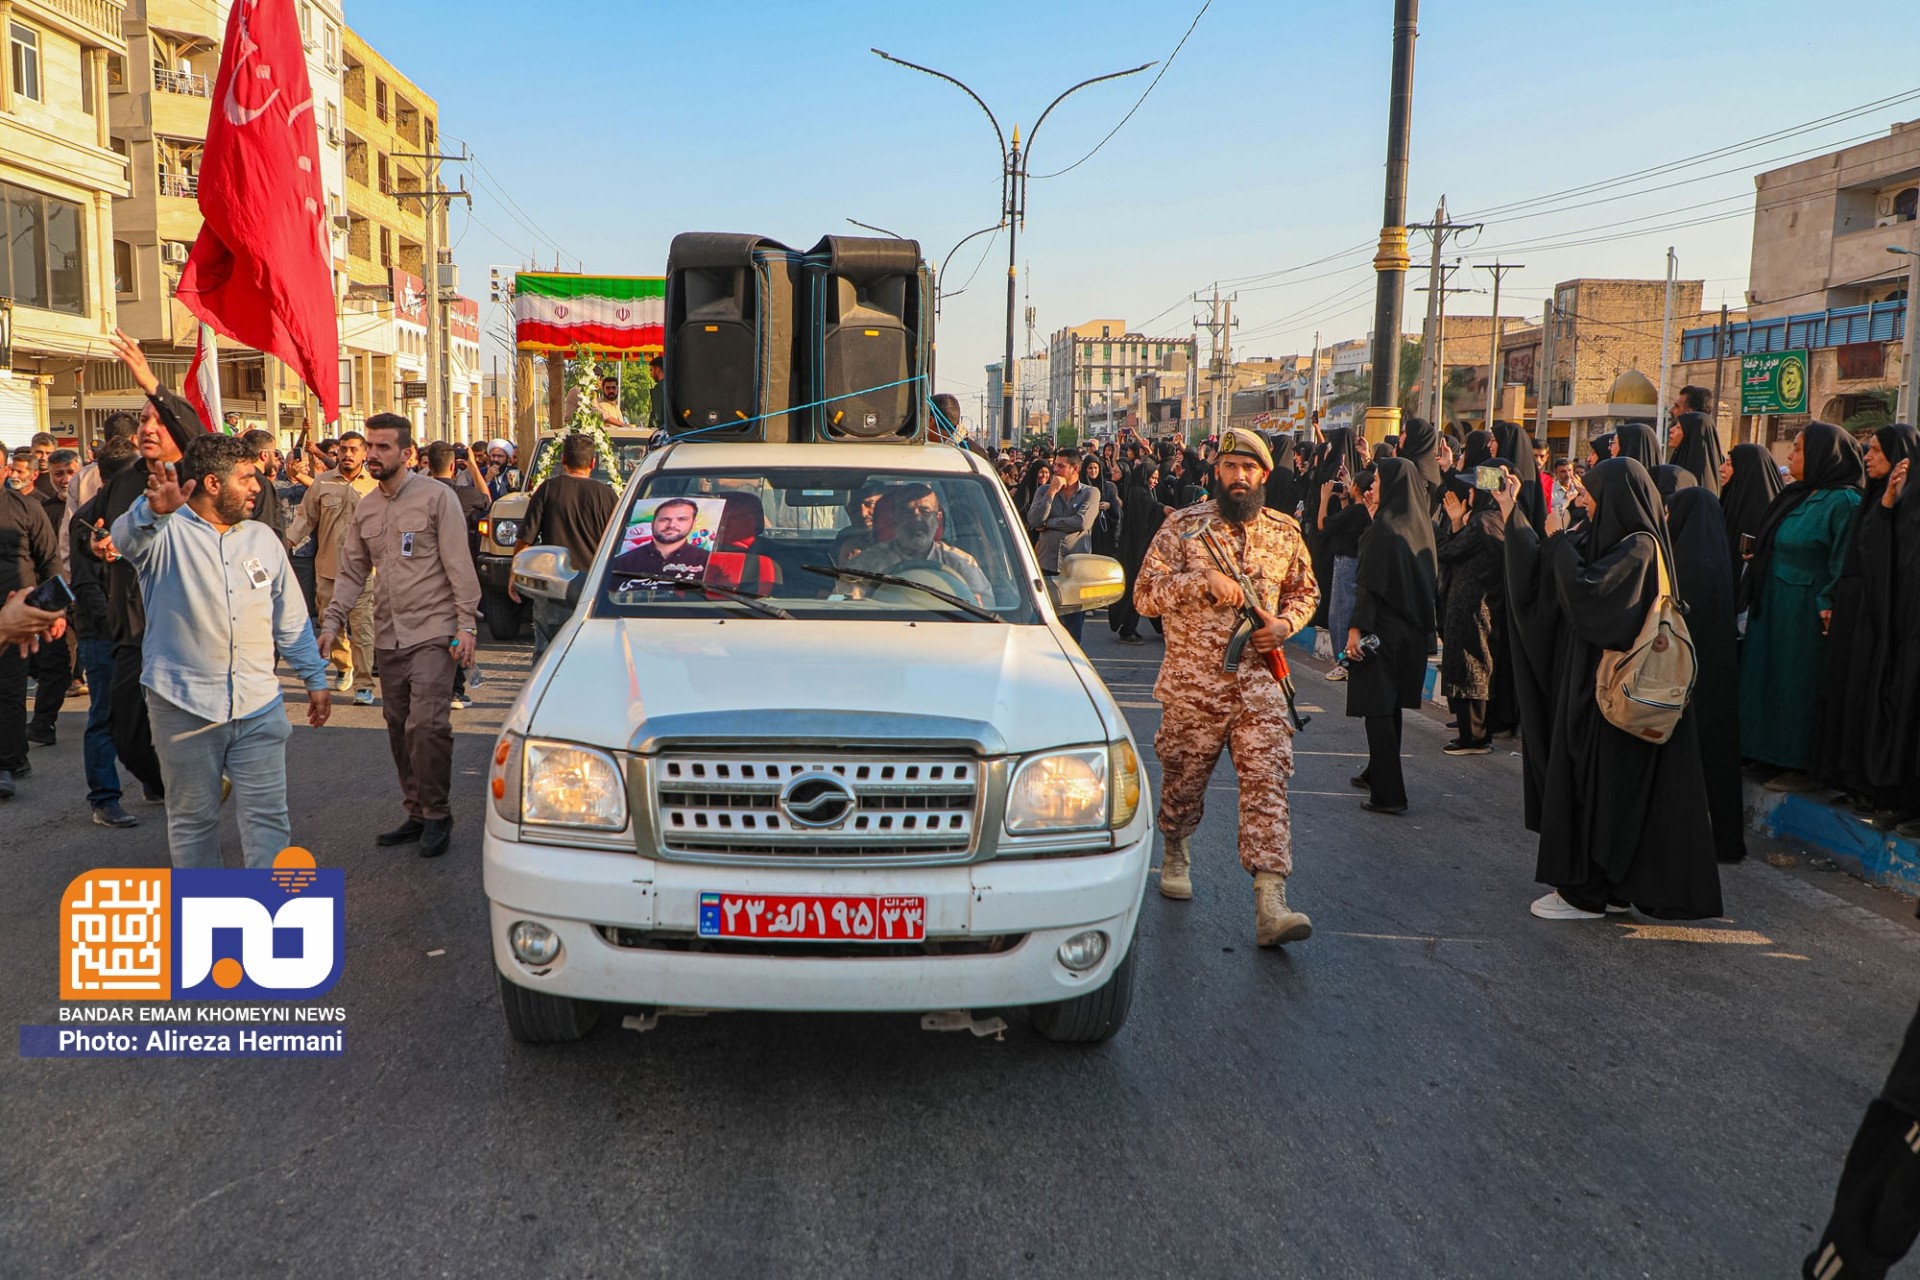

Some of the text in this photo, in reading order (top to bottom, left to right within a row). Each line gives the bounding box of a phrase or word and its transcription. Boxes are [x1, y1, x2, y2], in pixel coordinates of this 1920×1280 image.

[884, 898, 919, 907] ایران
[722, 897, 766, 933] ۲۳
[813, 901, 874, 936] ۱۹۵
[881, 907, 922, 938] ۳۳
